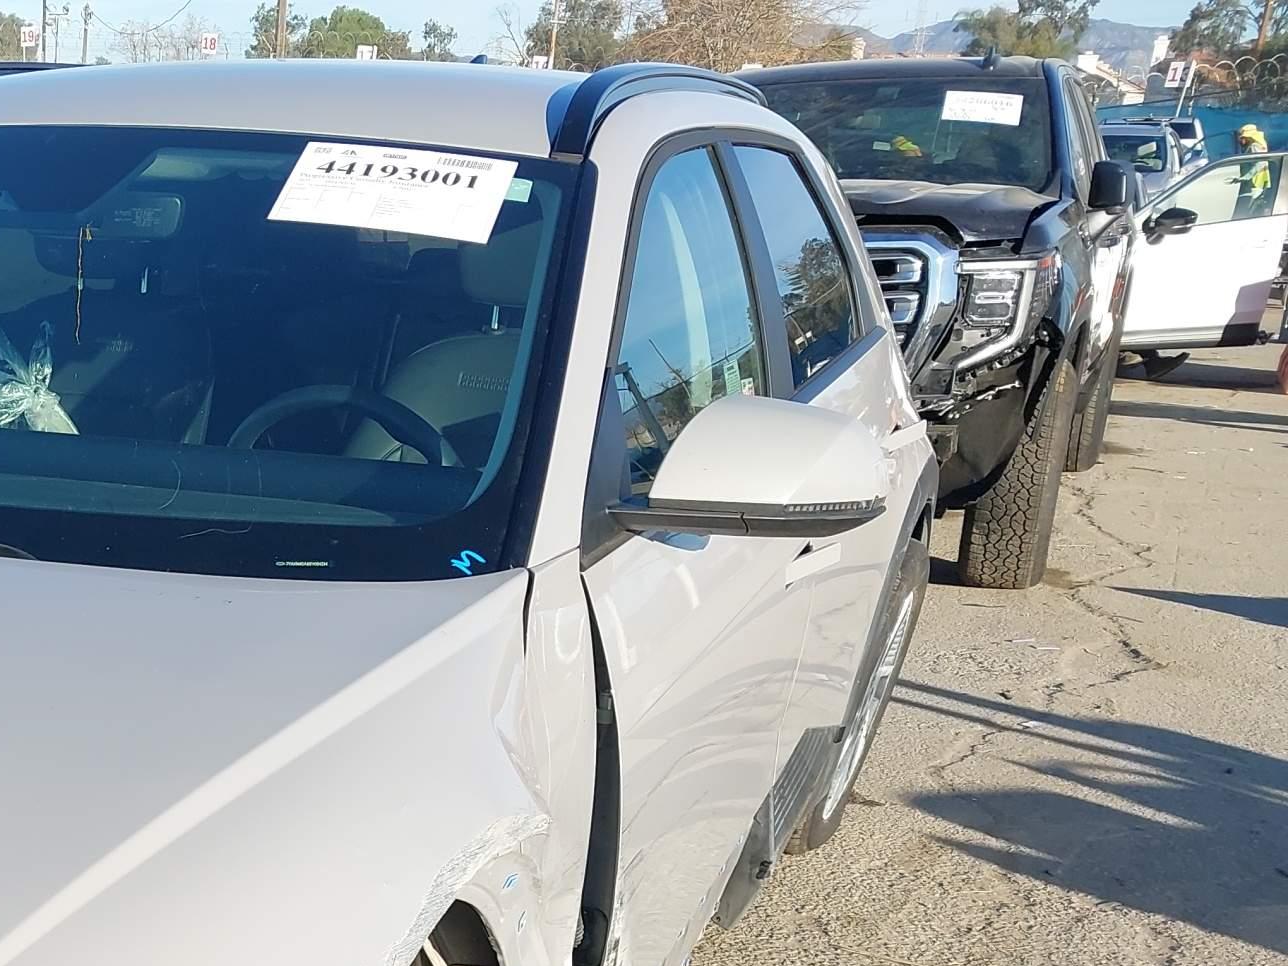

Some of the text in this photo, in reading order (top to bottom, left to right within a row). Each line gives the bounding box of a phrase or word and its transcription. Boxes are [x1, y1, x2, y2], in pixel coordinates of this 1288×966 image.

[21, 31, 34, 43] 19
[203, 37, 216, 50] 18
[316, 160, 479, 189] 44193001
